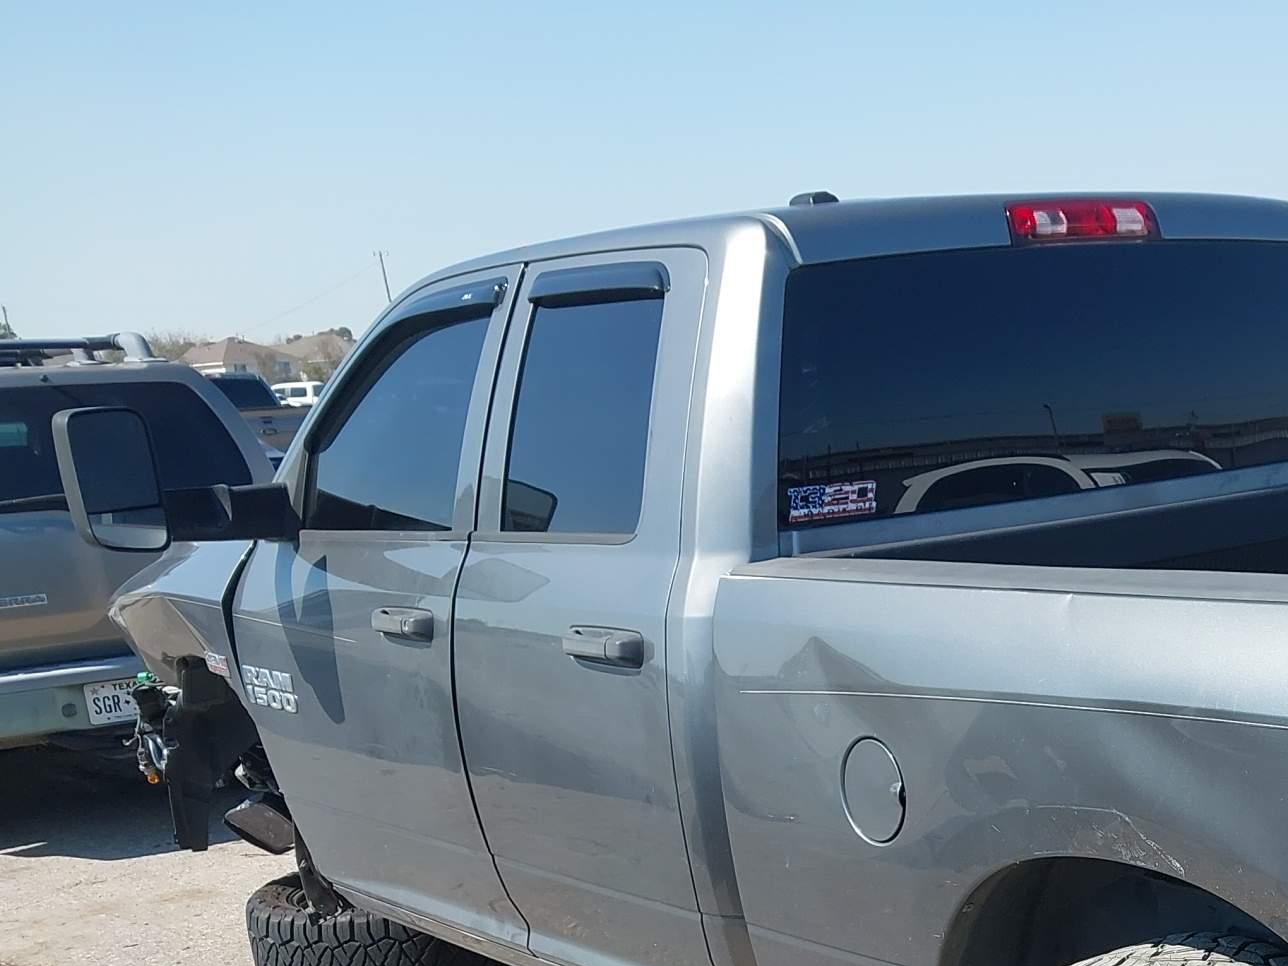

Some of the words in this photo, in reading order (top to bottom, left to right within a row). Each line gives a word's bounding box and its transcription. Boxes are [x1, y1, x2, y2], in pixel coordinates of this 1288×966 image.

[111, 680, 138, 691] TEXA
[241, 664, 294, 692] RAM
[92, 694, 122, 715] SGR
[246, 684, 298, 714] 1500
